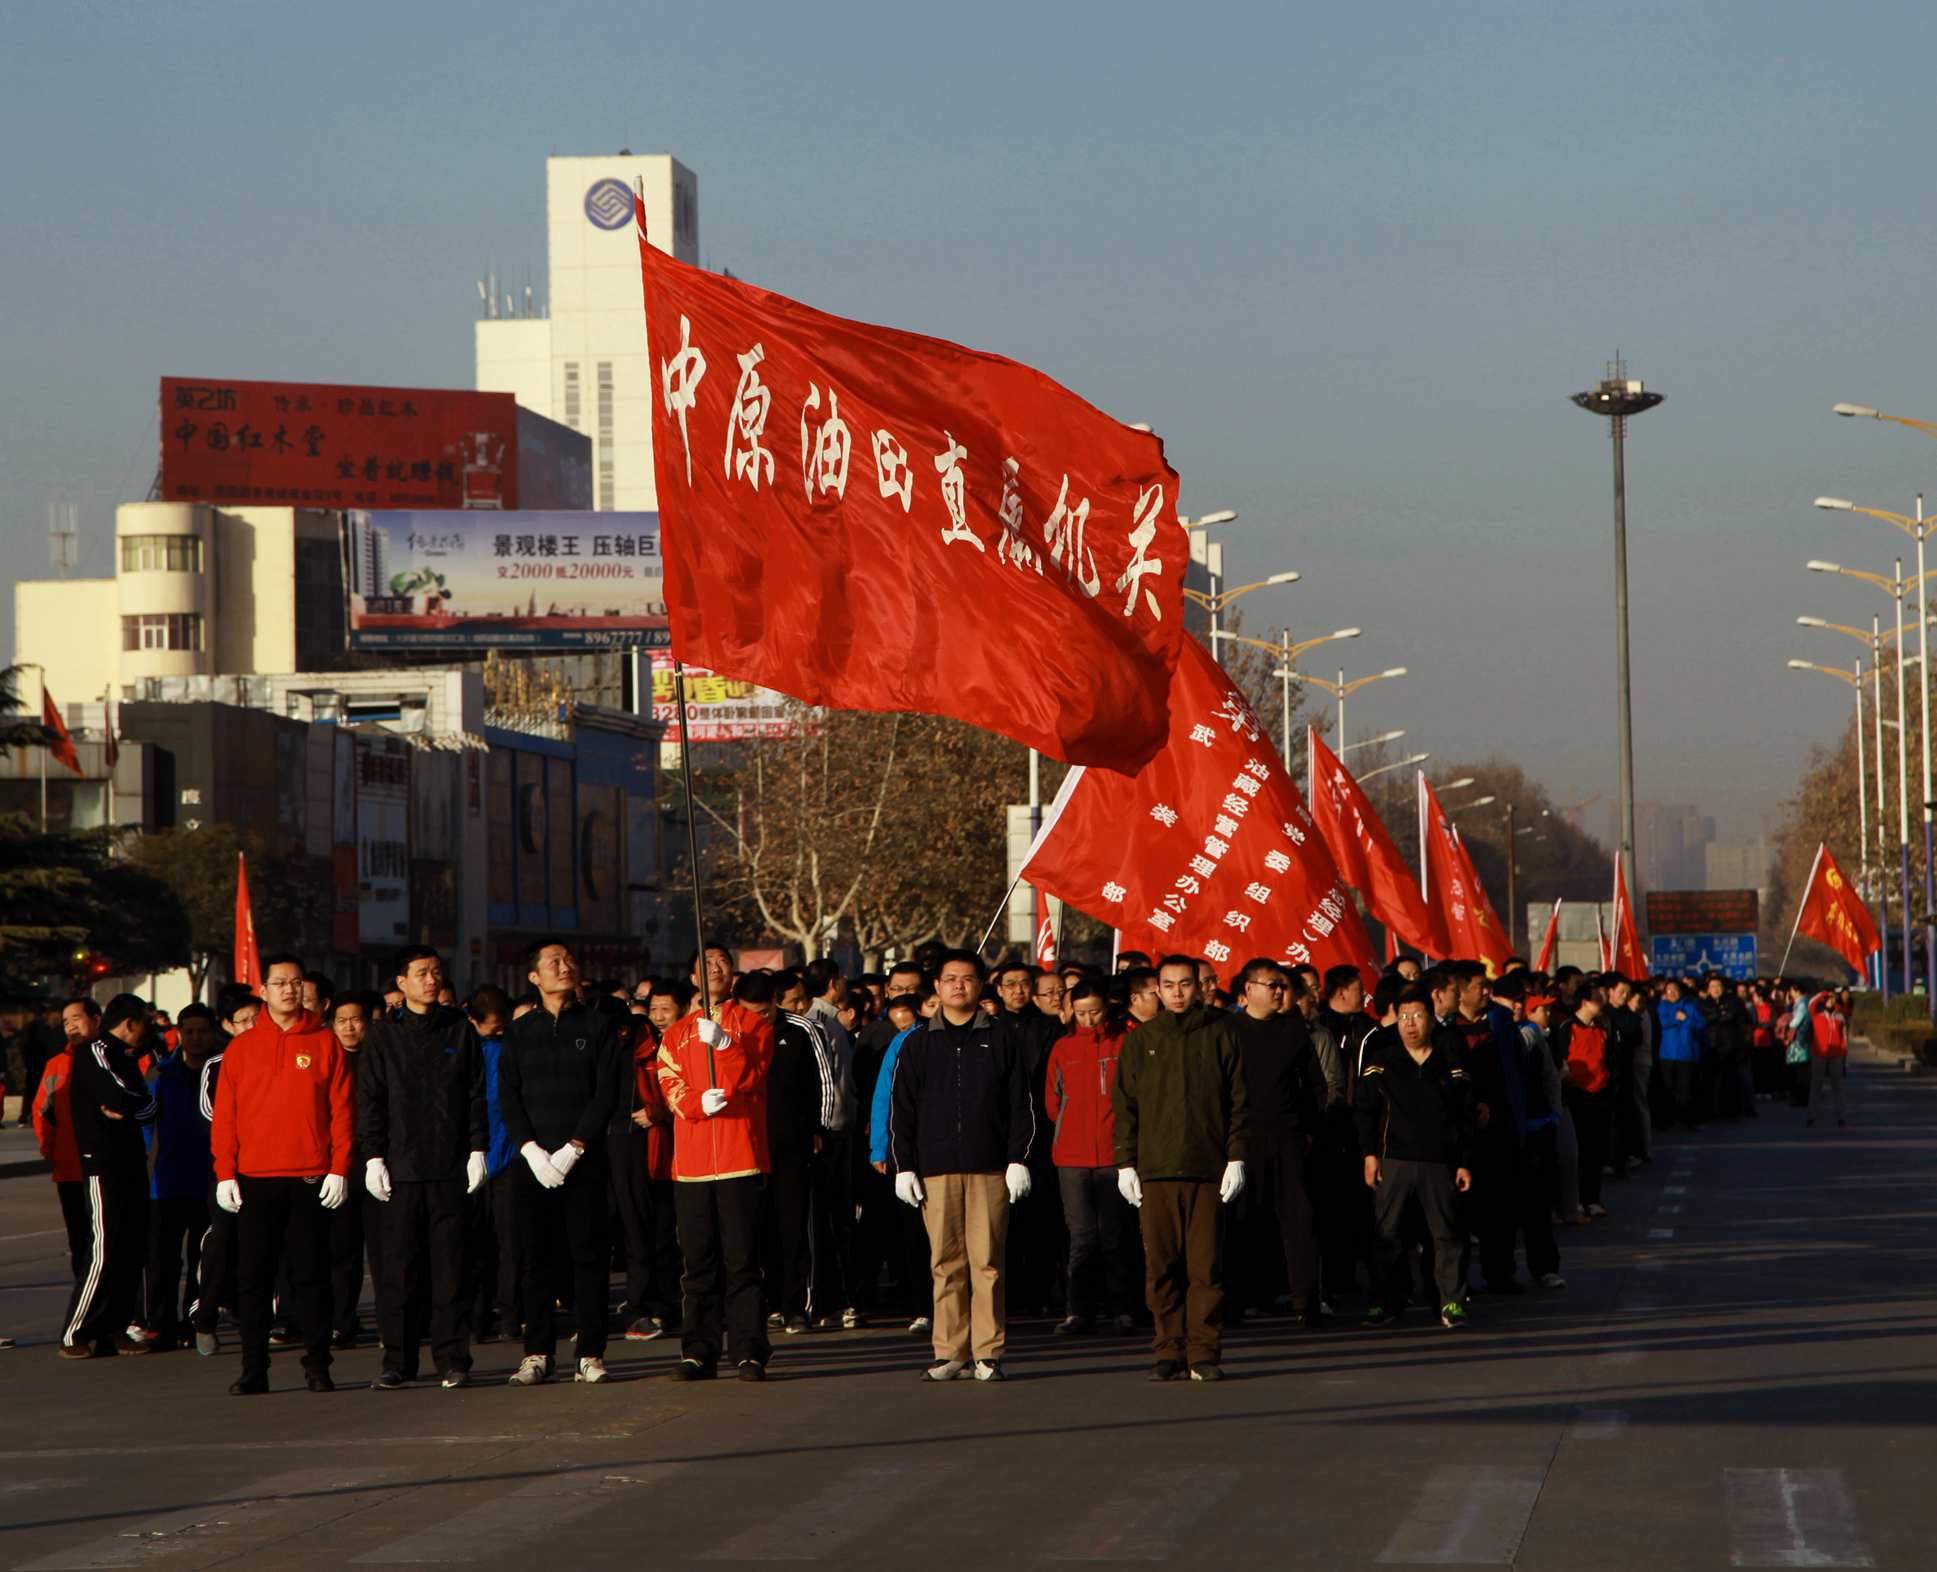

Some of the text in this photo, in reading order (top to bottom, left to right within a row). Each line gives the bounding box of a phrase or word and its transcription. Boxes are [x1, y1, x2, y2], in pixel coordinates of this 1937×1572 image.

[175, 423, 327, 459] 中国红木堂
[493, 534, 580, 556] 景观楼王
[592, 534, 662, 556] 压轴巨
[1101, 722, 1216, 904] 武装部
[1147, 758, 1270, 933] 油藏经营管理办公室
